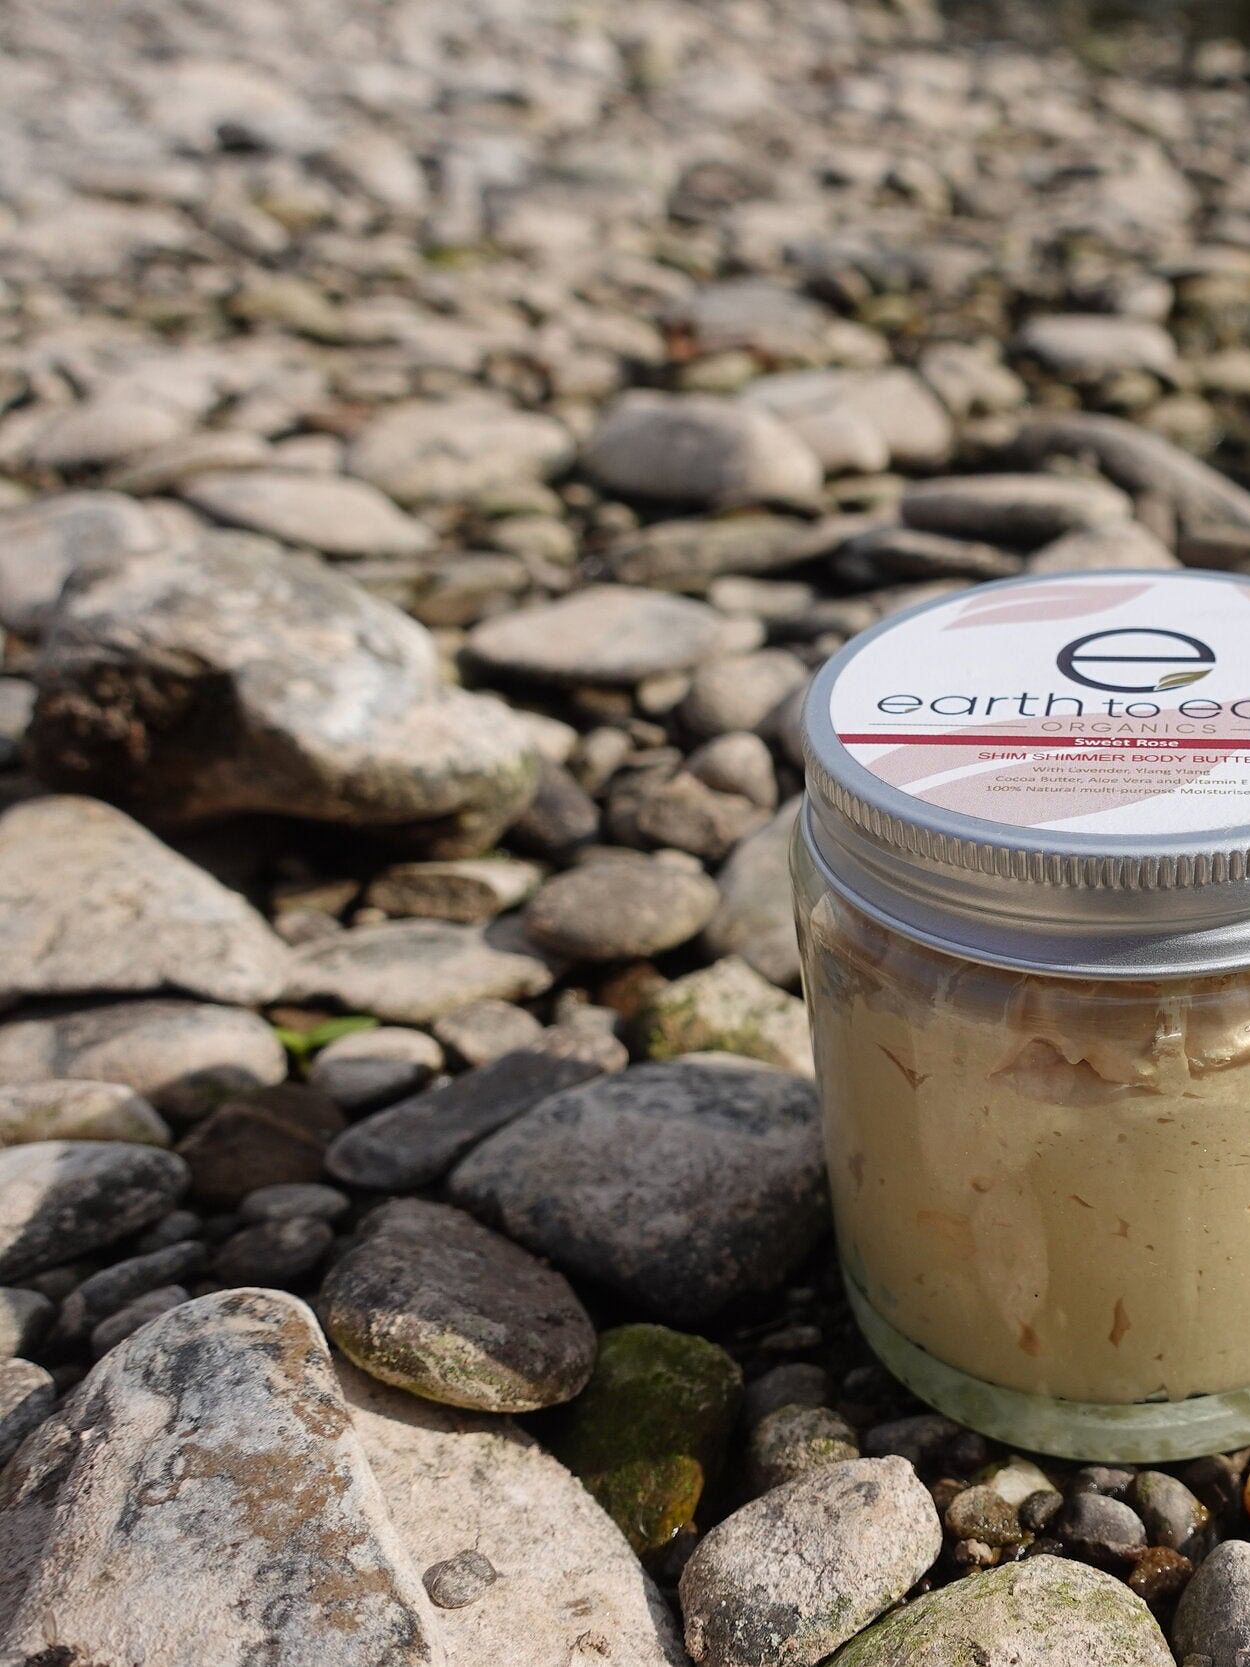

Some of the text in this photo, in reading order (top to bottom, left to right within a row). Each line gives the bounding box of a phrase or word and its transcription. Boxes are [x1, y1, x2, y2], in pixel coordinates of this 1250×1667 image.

[877, 692, 1084, 718] earth
[1102, 698, 1160, 719] to
[1041, 721, 1217, 734] ORGANICS
[1074, 738, 1179, 748] Sweet Rose
[978, 752, 1028, 761] SHIM
[1032, 753, 1126, 762] SHIMMER
[1132, 754, 1187, 763] BODY
[1032, 766, 1211, 776] With Lavender, Ylang Ylang
[995, 775, 1036, 783] Cocoa
[1040, 776, 1083, 784] Butter,
[1123, 777, 1153, 785] Vera
[1156, 777, 1181, 785] and
[1186, 778, 1237, 786] Vitamin
[986, 784, 1022, 793] 100%
[1026, 785, 1076, 793] Natural
[1080, 786, 1175, 795] multi-purpose
